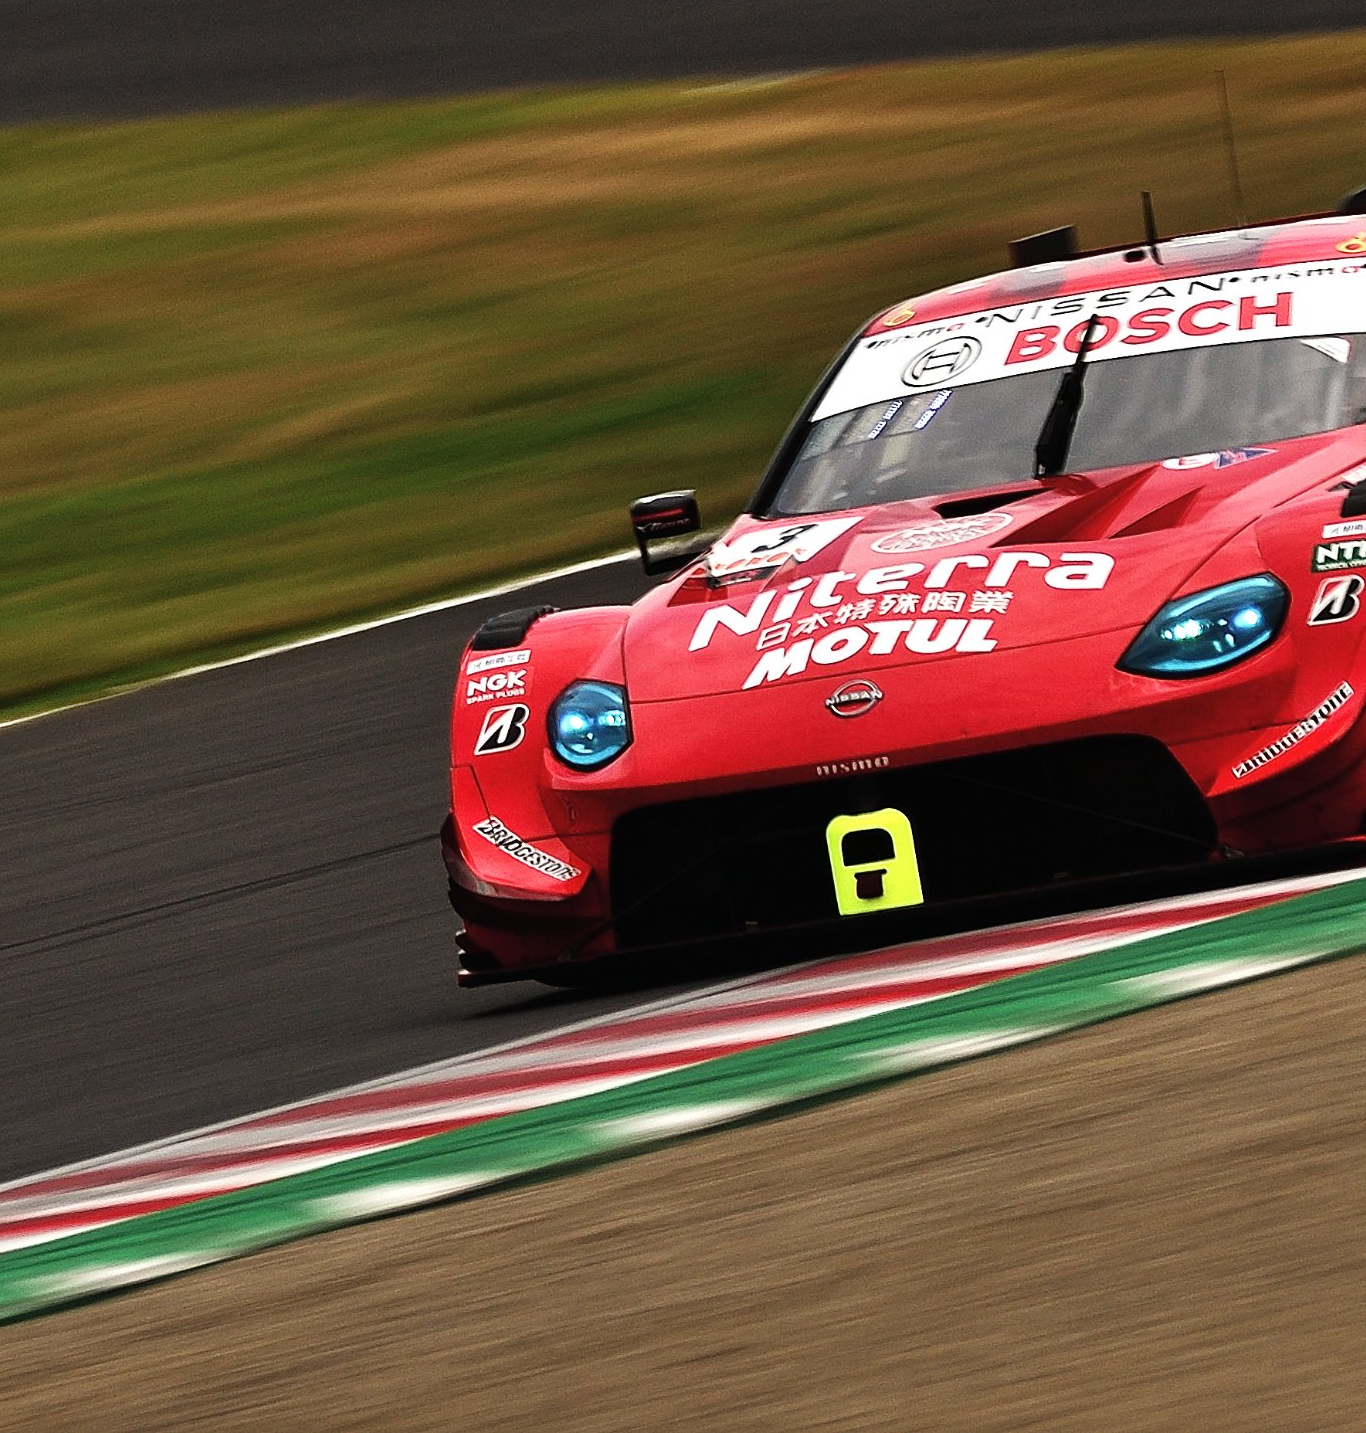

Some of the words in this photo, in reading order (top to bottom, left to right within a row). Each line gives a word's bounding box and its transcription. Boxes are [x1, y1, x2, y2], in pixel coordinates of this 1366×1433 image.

[986, 277, 1226, 328] NISSAN
[1004, 291, 1294, 366] BOSCH
[750, 523, 819, 553] 3
[688, 551, 1115, 652] Niterra
[756, 590, 1014, 651] 日本特殊陶業
[740, 618, 999, 690] MOTUL
[466, 669, 527, 698] NGK
[496, 688, 525, 699] PLUGS
[825, 690, 883, 706] NISSAN
[475, 817, 581, 880] BRIDGESTONE
